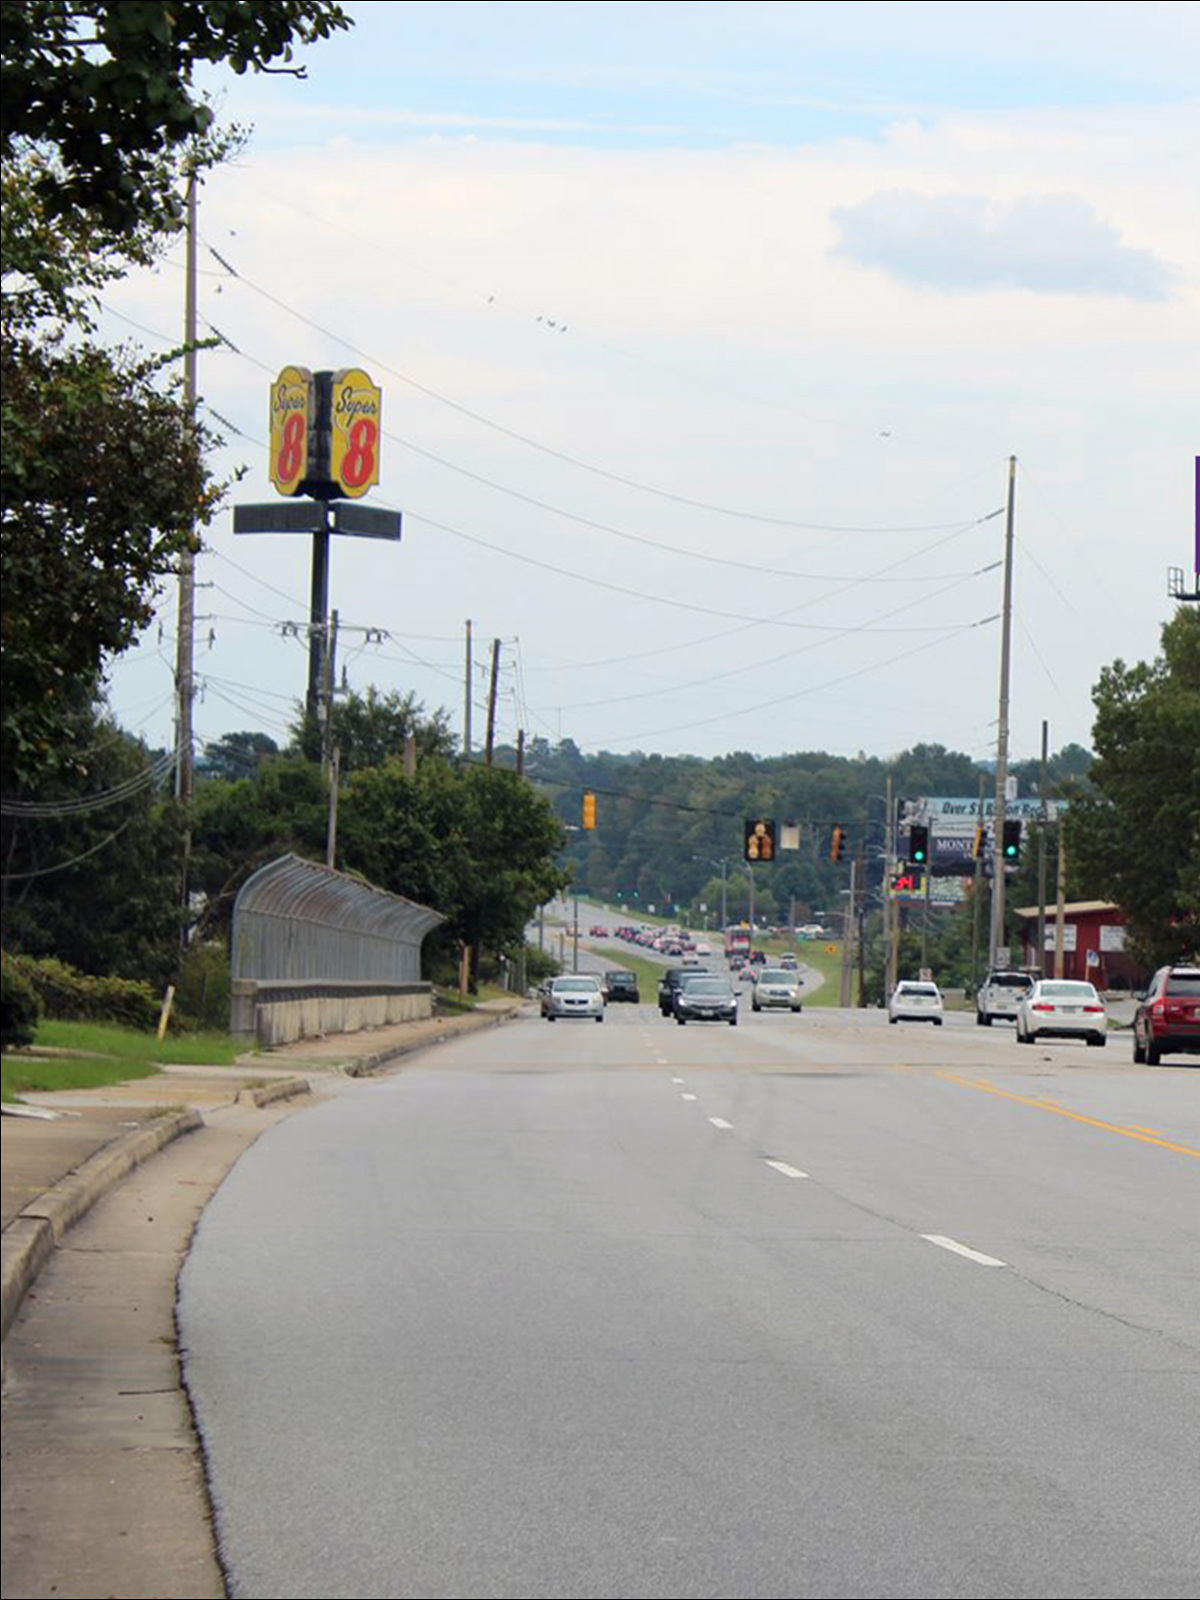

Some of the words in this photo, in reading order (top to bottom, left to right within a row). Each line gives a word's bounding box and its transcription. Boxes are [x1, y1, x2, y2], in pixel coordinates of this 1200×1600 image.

[274, 384, 306, 425] Super
[336, 386, 377, 427] Super
[277, 412, 305, 484] 8
[341, 418, 376, 487] 8
[942, 801, 967, 815] Over
